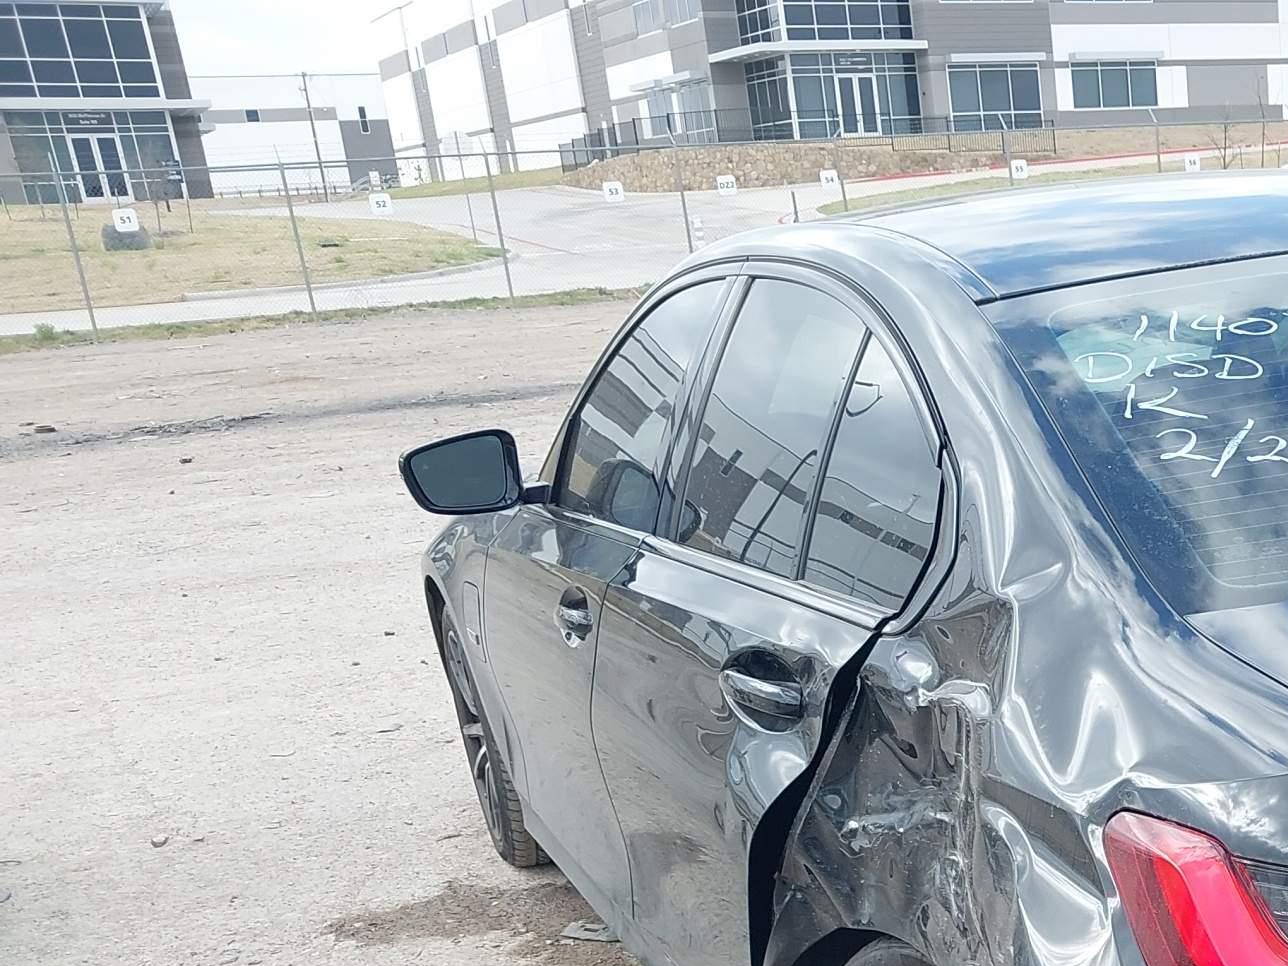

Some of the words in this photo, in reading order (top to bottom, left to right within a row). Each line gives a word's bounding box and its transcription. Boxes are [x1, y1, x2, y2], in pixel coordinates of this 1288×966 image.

[608, 188, 619, 197] 53
[375, 200, 388, 209] 52
[119, 216, 132, 224] 51
